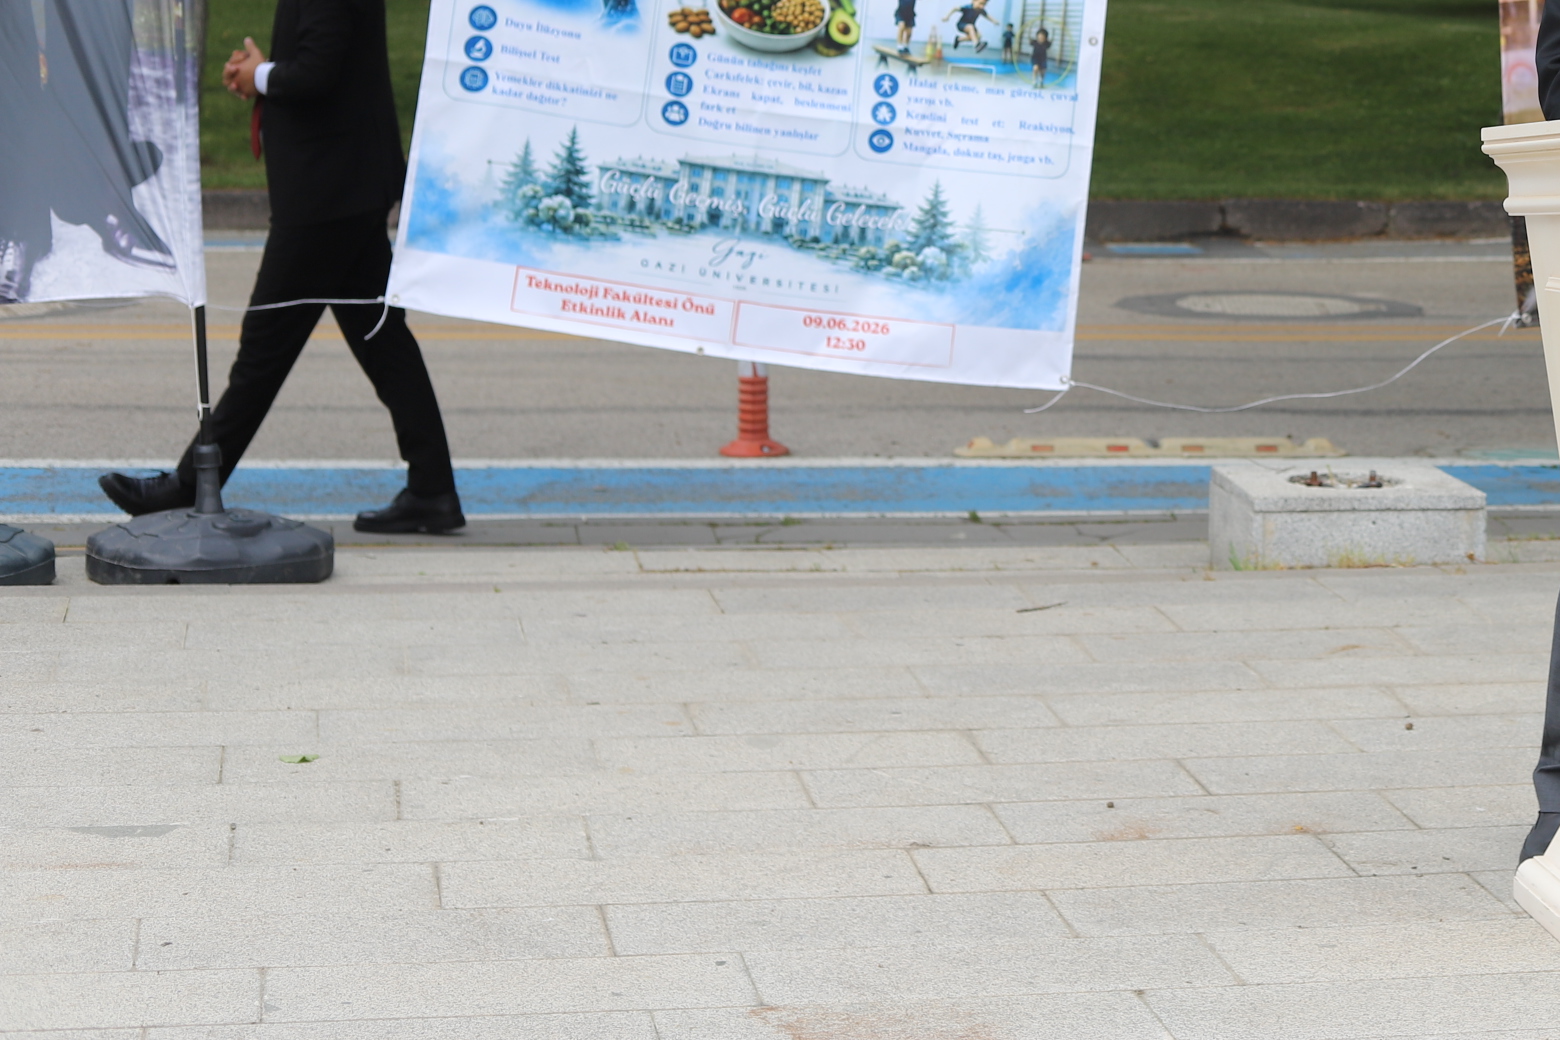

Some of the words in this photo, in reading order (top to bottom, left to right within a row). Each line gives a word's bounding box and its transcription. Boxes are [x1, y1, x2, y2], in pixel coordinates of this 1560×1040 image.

[505, 17, 532, 33] Duyu
[540, 49, 561, 64] Test
[707, 52, 745, 66] Günün
[747, 58, 790, 74] tabağını
[791, 63, 823, 77] keşfet
[494, 71, 544, 89] Yemekler
[908, 77, 938, 91] Halat
[491, 85, 524, 99] kadar
[702, 84, 741, 99] Ekranı
[817, 85, 849, 97] kazan
[700, 100, 724, 113] fark
[725, 105, 737, 115] et
[698, 116, 732, 132] Doğru
[734, 123, 772, 137] bilinen
[905, 109, 948, 124] Kendini
[961, 116, 979, 127] test
[952, 148, 986, 159] dokuz
[1006, 152, 1036, 165] jenga
[640, 257, 688, 274] GAZİ
[697, 265, 840, 296] ÜNİVERSİTESİ
[525, 274, 600, 301] Teknoloji
[602, 287, 679, 311] Fakültesi
[681, 296, 716, 317] Önü
[560, 299, 626, 322] Etkinlik
[629, 308, 675, 328] Alanı
[802, 314, 890, 337] 09.06.2026
[825, 336, 867, 353] 12:30
